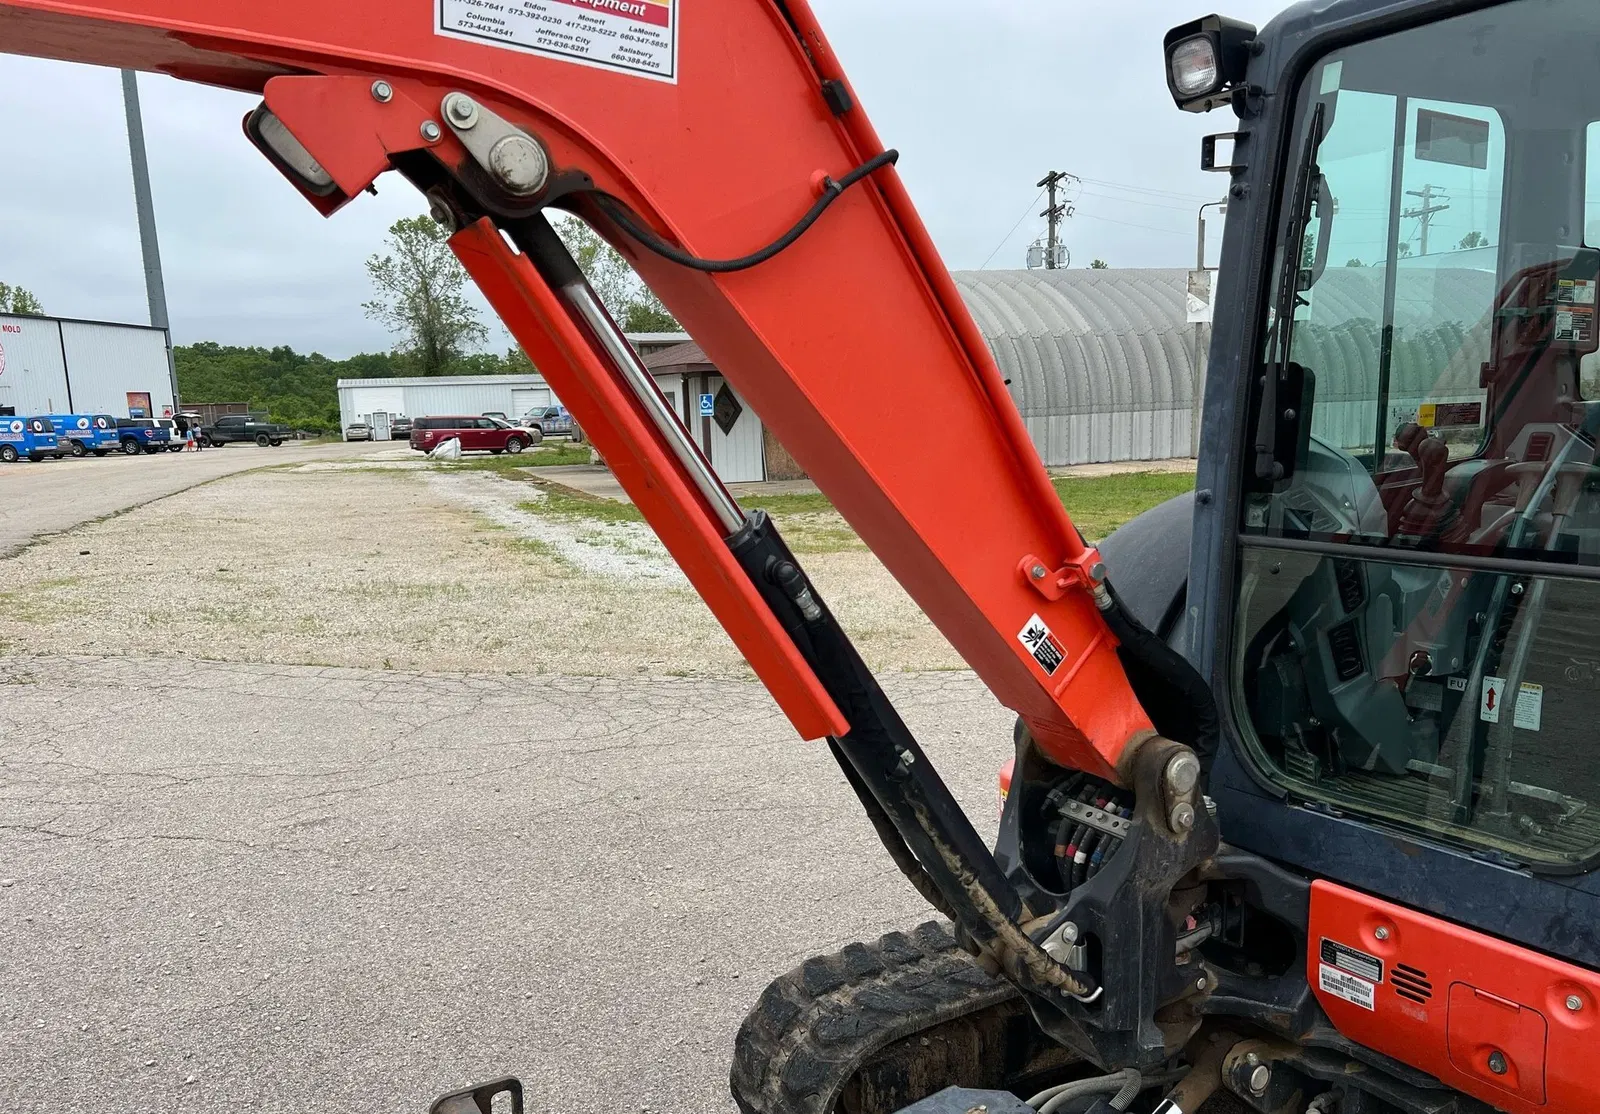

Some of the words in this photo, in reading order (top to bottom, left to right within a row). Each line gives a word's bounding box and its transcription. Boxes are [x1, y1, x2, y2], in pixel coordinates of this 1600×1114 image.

[523, 1, 547, 12] Eldon
[466, 11, 506, 26] Columbia
[507, 7, 562, 26] 573-392-0230
[577, 14, 606, 26] Monett
[457, 19, 514, 37] 573-443-4541
[565, 21, 617, 38] 417-235-5222
[628, 25, 661, 38] LaMonte
[535, 27, 573, 41] Jefferson
[575, 35, 591, 46] City
[618, 45, 654, 60] Salisbury
[2, 324, 21, 334] MOLD
